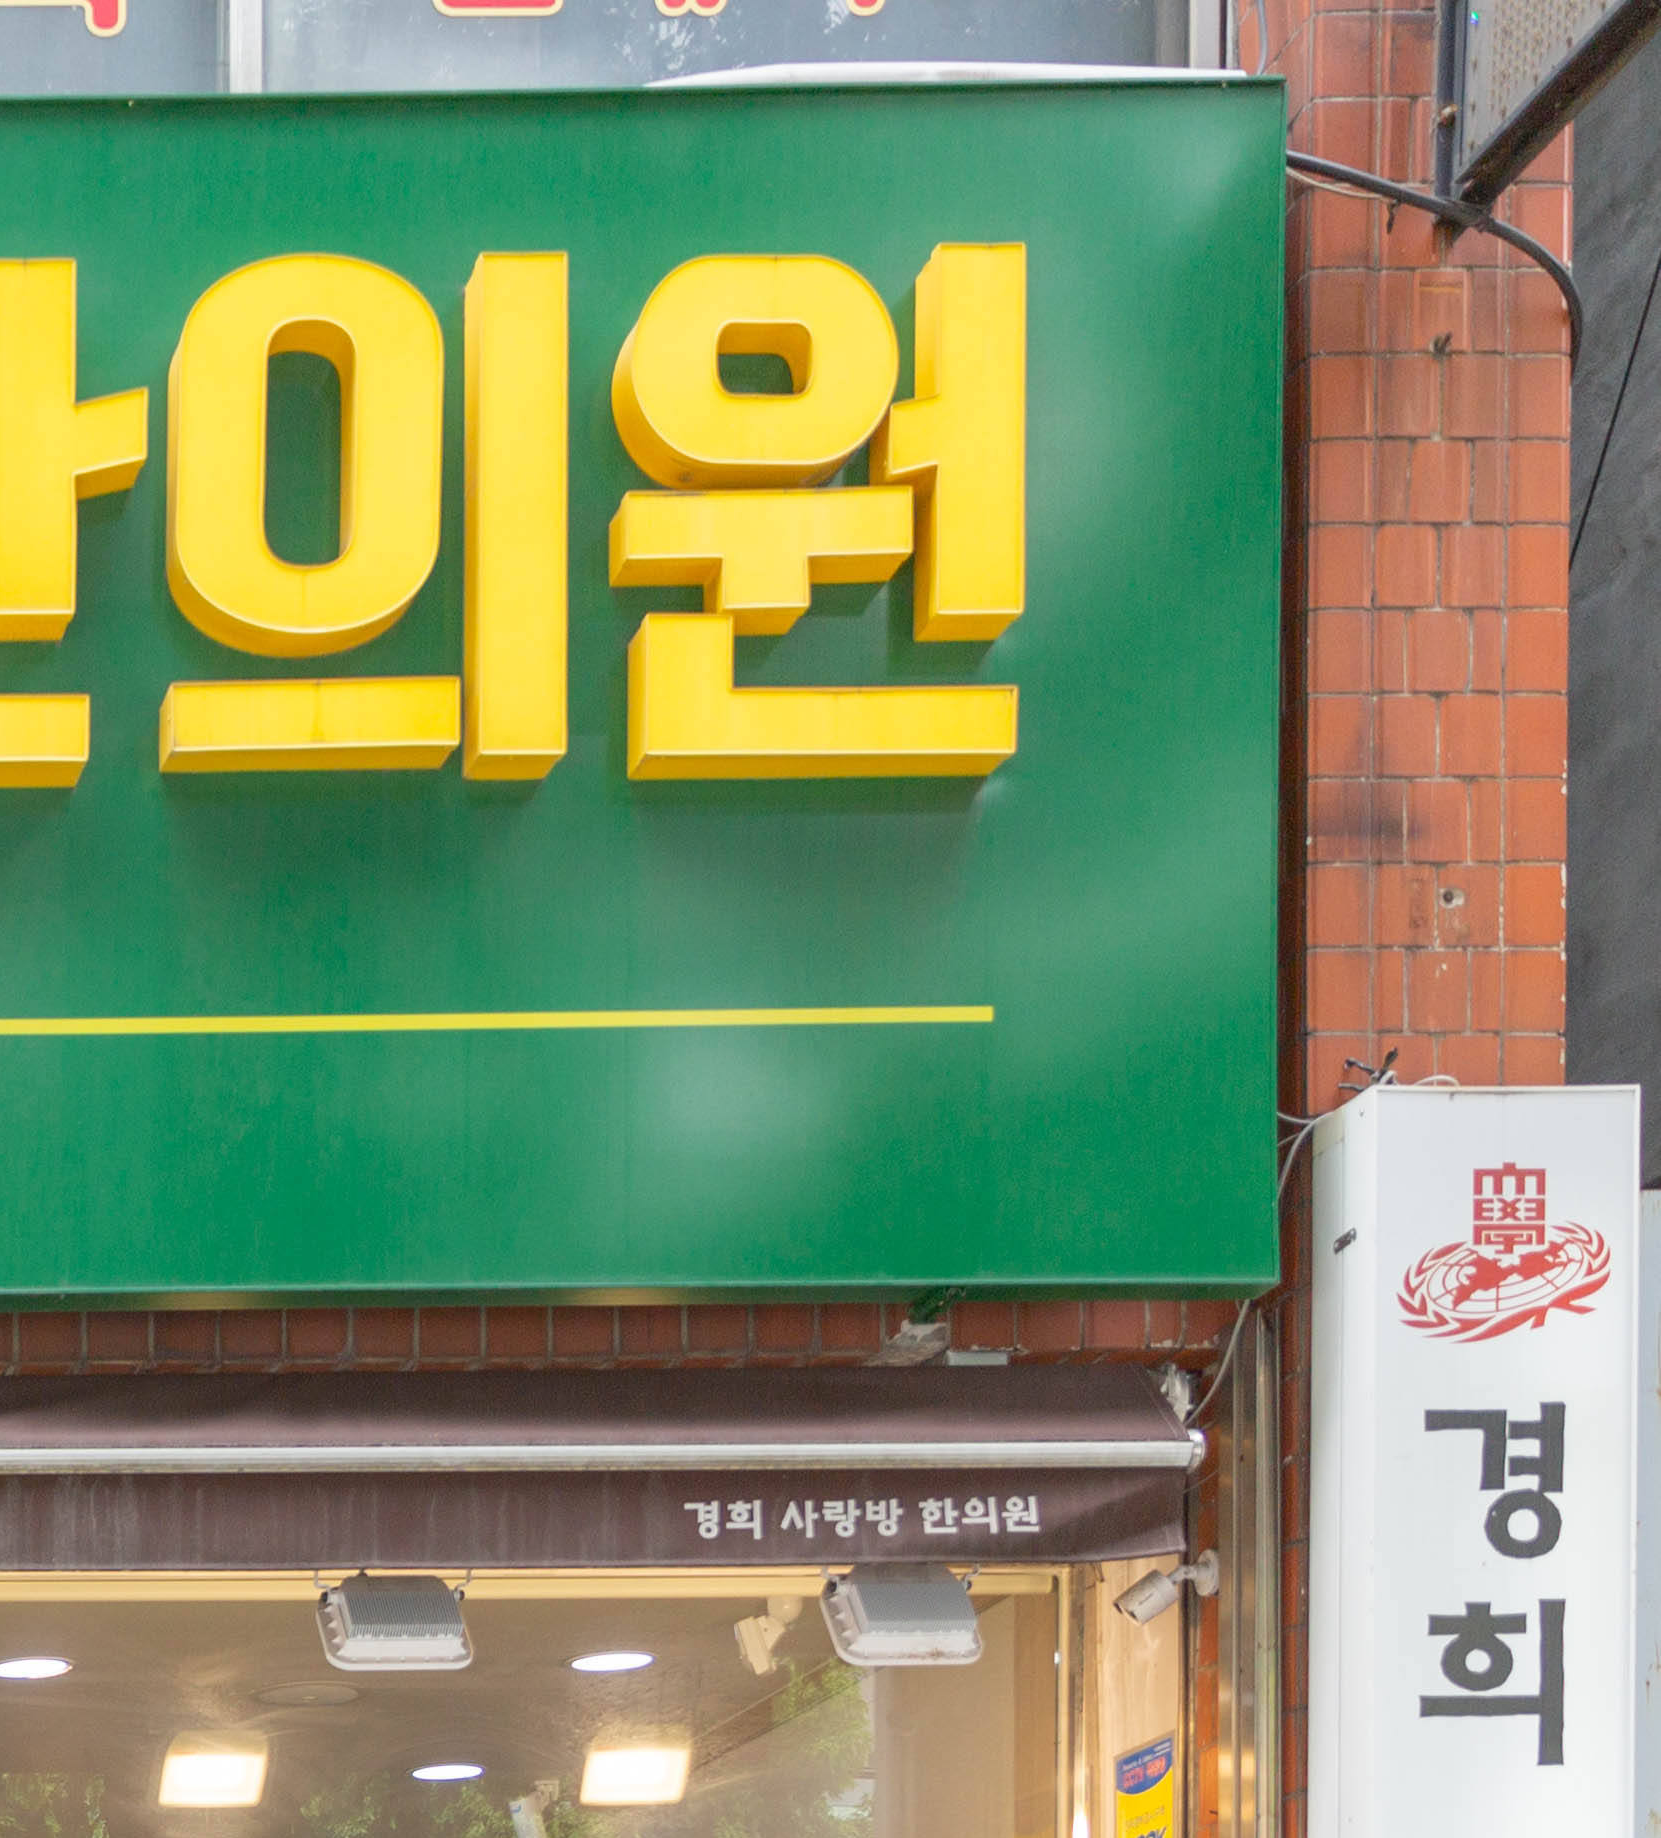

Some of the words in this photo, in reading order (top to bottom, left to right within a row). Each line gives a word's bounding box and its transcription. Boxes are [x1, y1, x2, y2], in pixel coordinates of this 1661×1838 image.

[684, 1500, 764, 1540] 경희
[780, 1498, 904, 1539] 사랑방
[918, 1495, 1041, 1535] 한의원
[1419, 1401, 1568, 1767] 경희
